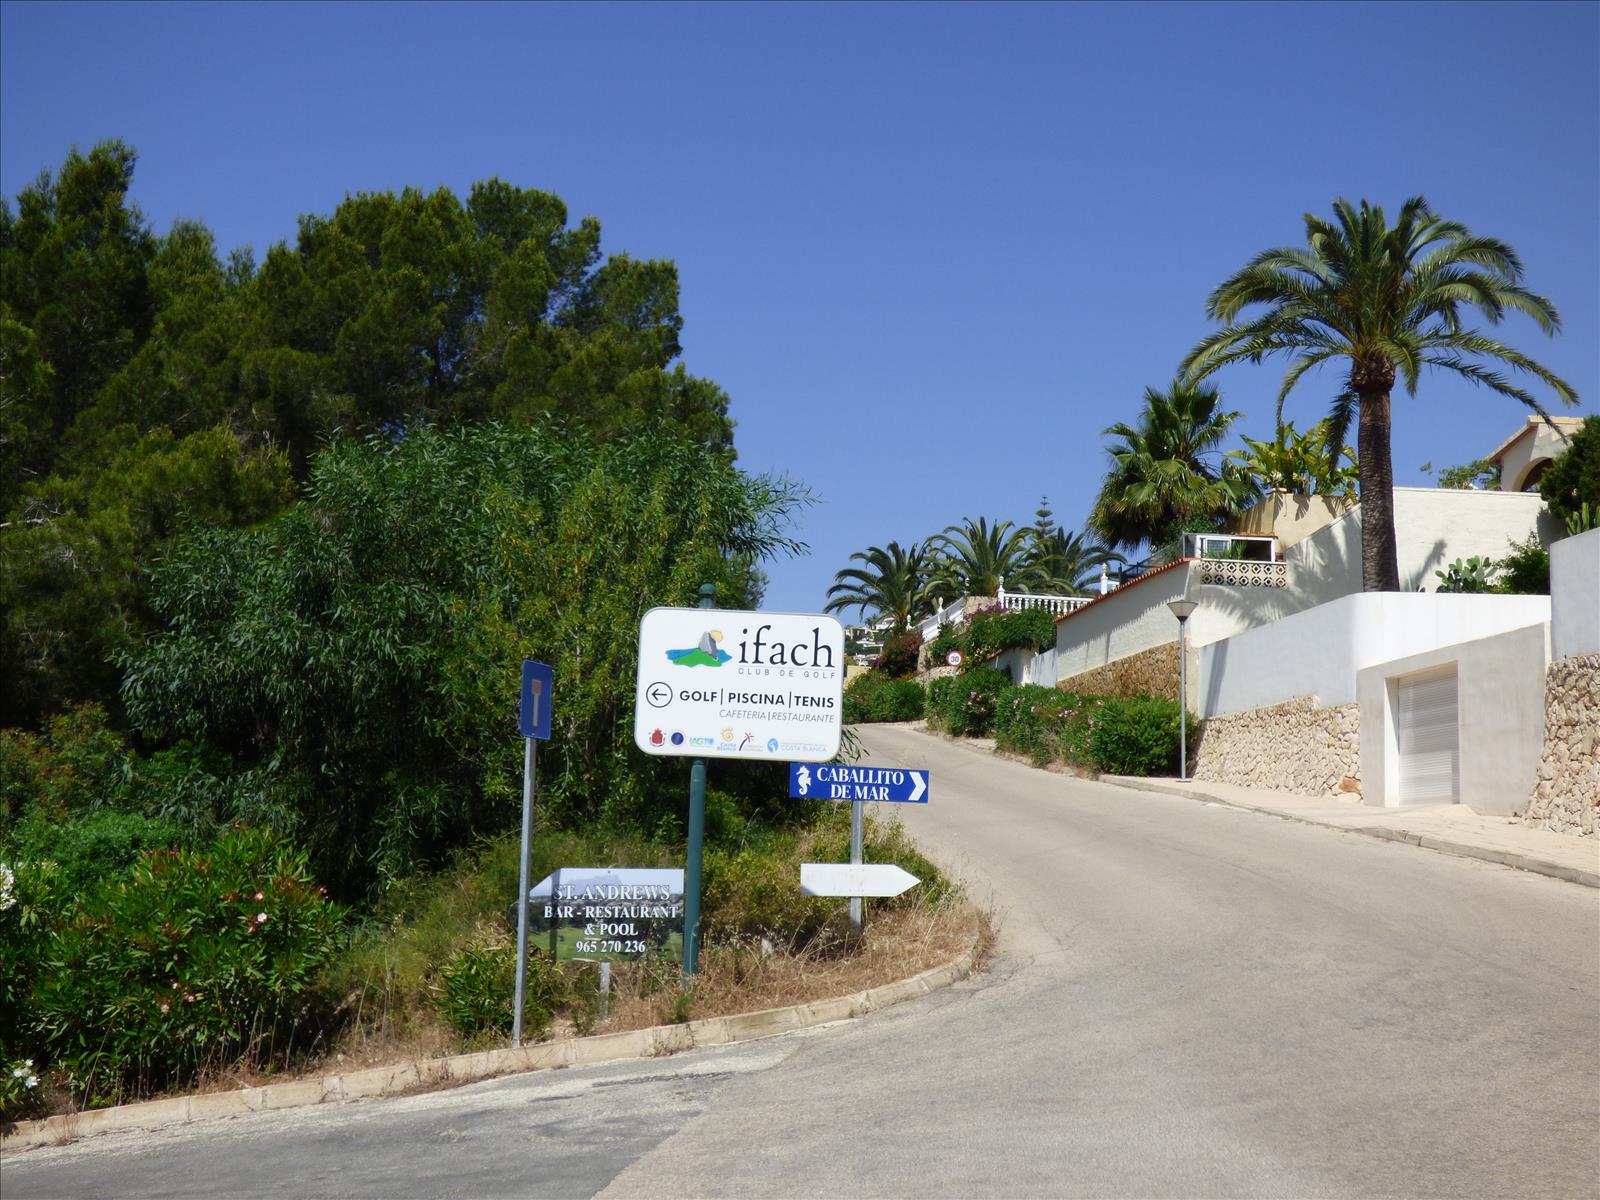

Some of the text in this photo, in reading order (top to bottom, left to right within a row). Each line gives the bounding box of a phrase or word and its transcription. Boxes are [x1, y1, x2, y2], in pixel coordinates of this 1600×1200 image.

[738, 625, 835, 668] ifach
[738, 668, 836, 679] CLUB DE GOLF
[679, 690, 834, 708] GOLF PISCINA TENIS
[719, 709, 835, 723] CAFETERIA RESTAURANTE
[816, 767, 905, 786] CABALLITO
[831, 784, 890, 801] DE MAR
[554, 884, 670, 900] ST. ANDREWS
[543, 906, 573, 918] BAR
[585, 906, 679, 918] RESTAURANT
[584, 923, 638, 935] & POOL
[576, 941, 646, 953] 965 270 236
